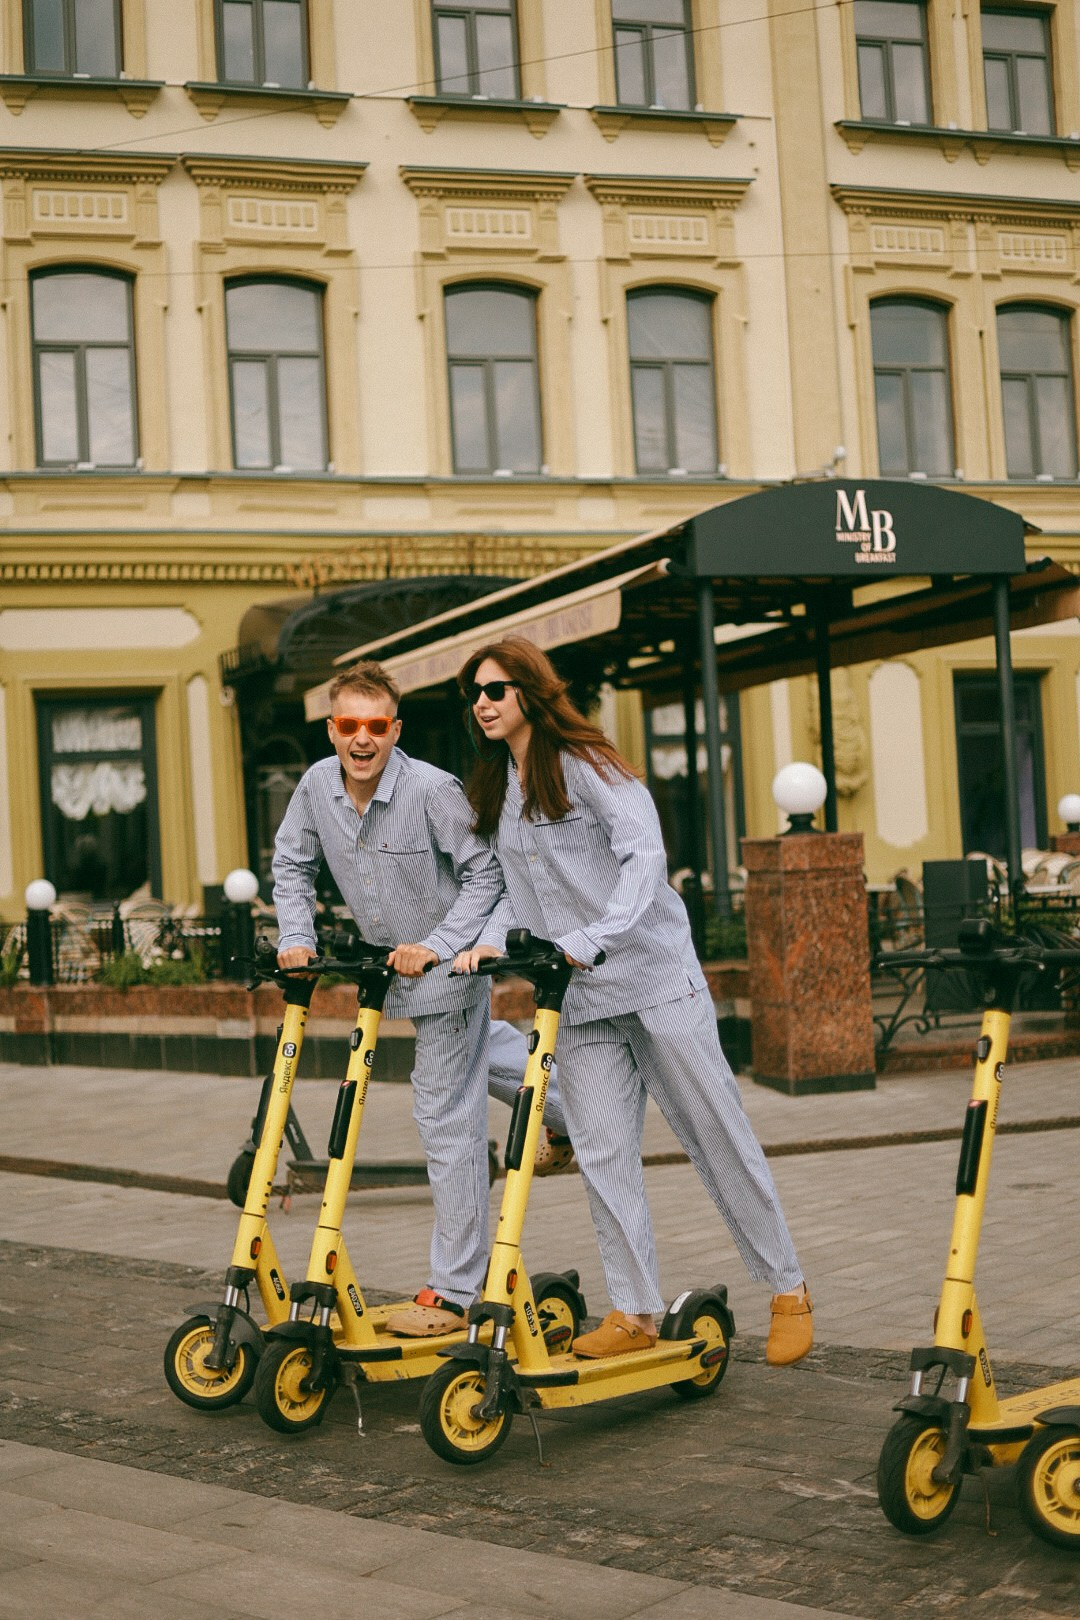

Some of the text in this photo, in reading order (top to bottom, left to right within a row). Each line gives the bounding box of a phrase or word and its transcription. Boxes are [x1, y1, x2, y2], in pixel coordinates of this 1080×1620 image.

[835, 532, 871, 542] MINISTRY
[860, 542, 872, 552] OF
[280, 1043, 296, 1093] Яндекс Go
[535, 1055, 553, 1112] Яндекс Go
